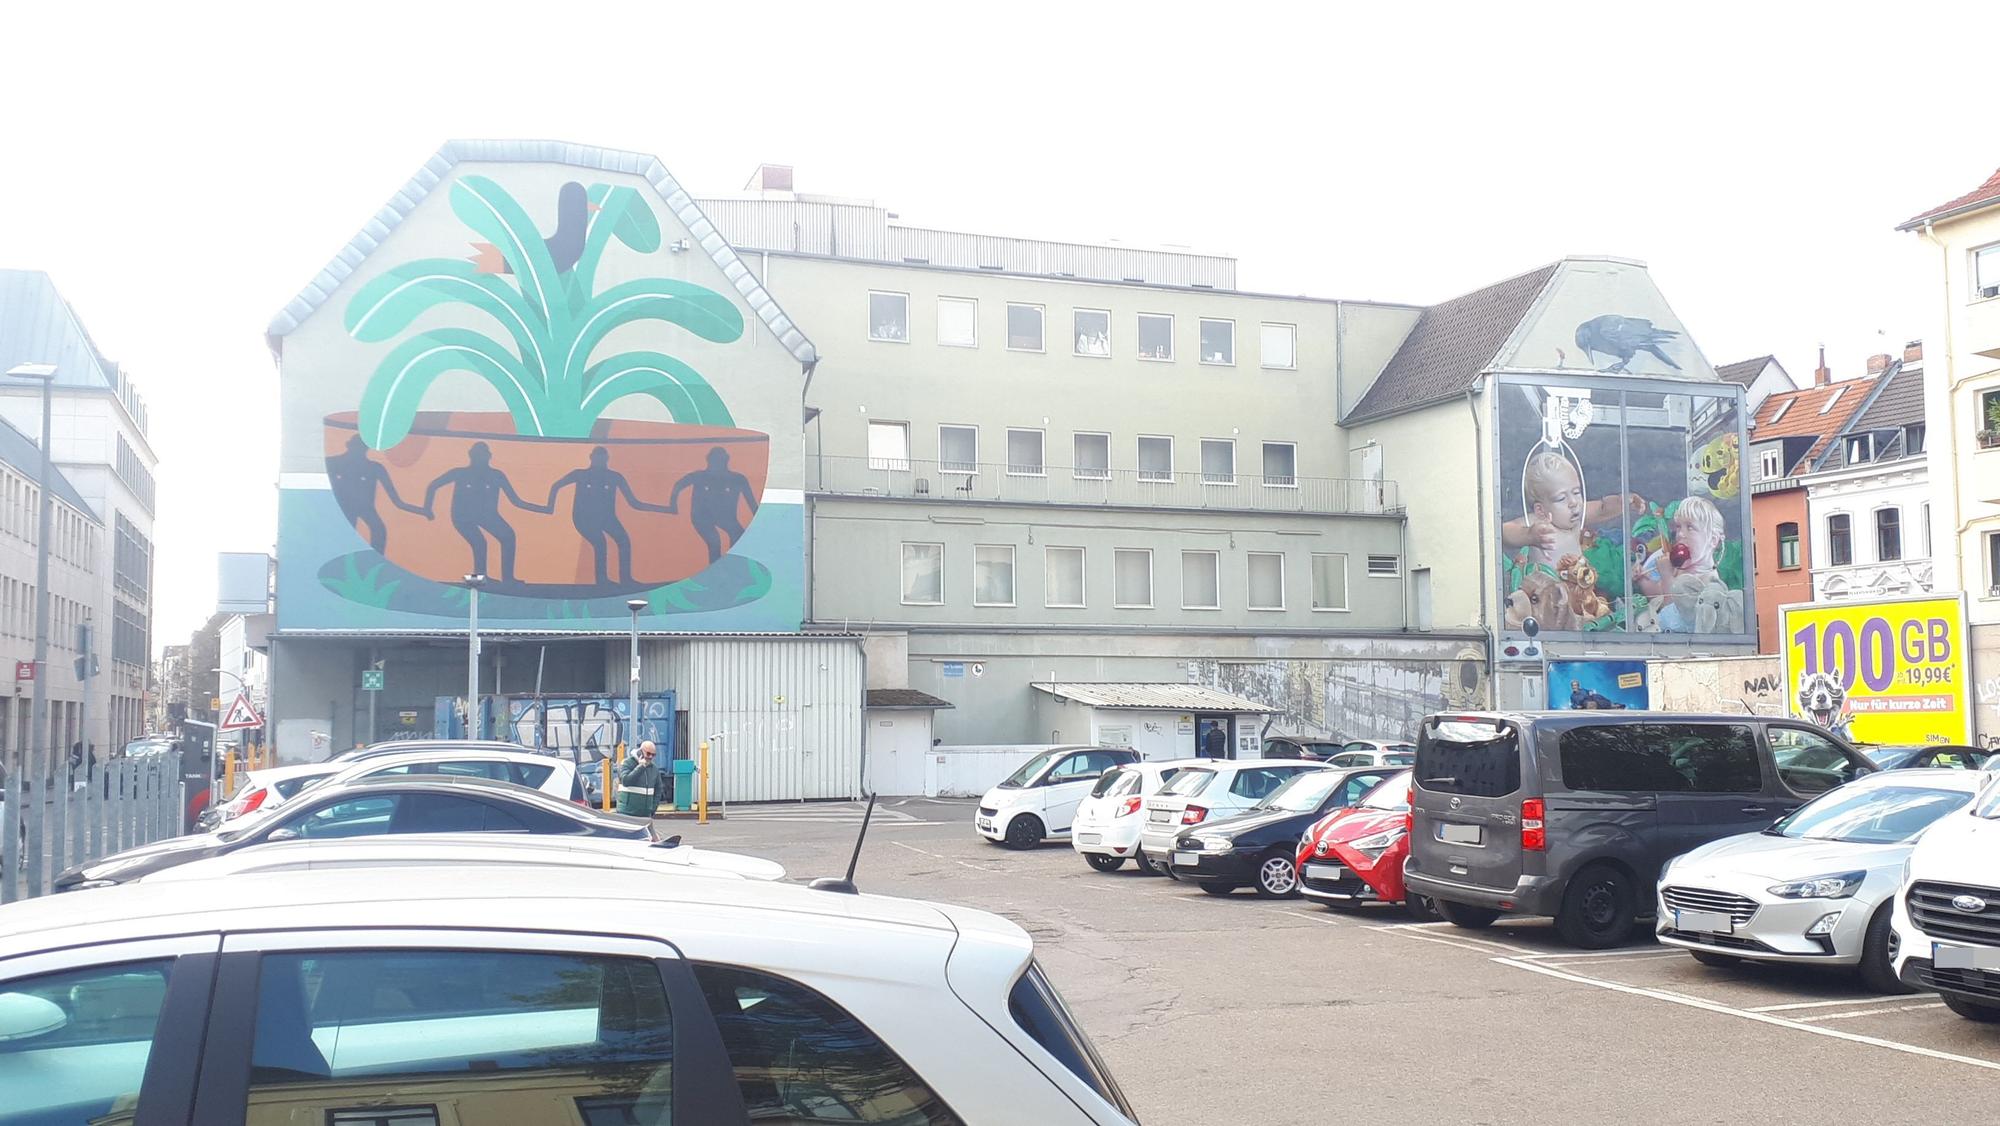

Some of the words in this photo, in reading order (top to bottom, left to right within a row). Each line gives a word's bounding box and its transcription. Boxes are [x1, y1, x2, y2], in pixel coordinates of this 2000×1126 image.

[1795, 617, 1894, 692] 100
[1901, 618, 1950, 663] GB
[1850, 699, 1870, 711] Nur
[1871, 699, 1888, 711] für
[1889, 699, 1921, 710] kurze
[1922, 697, 1946, 709] Zeit
